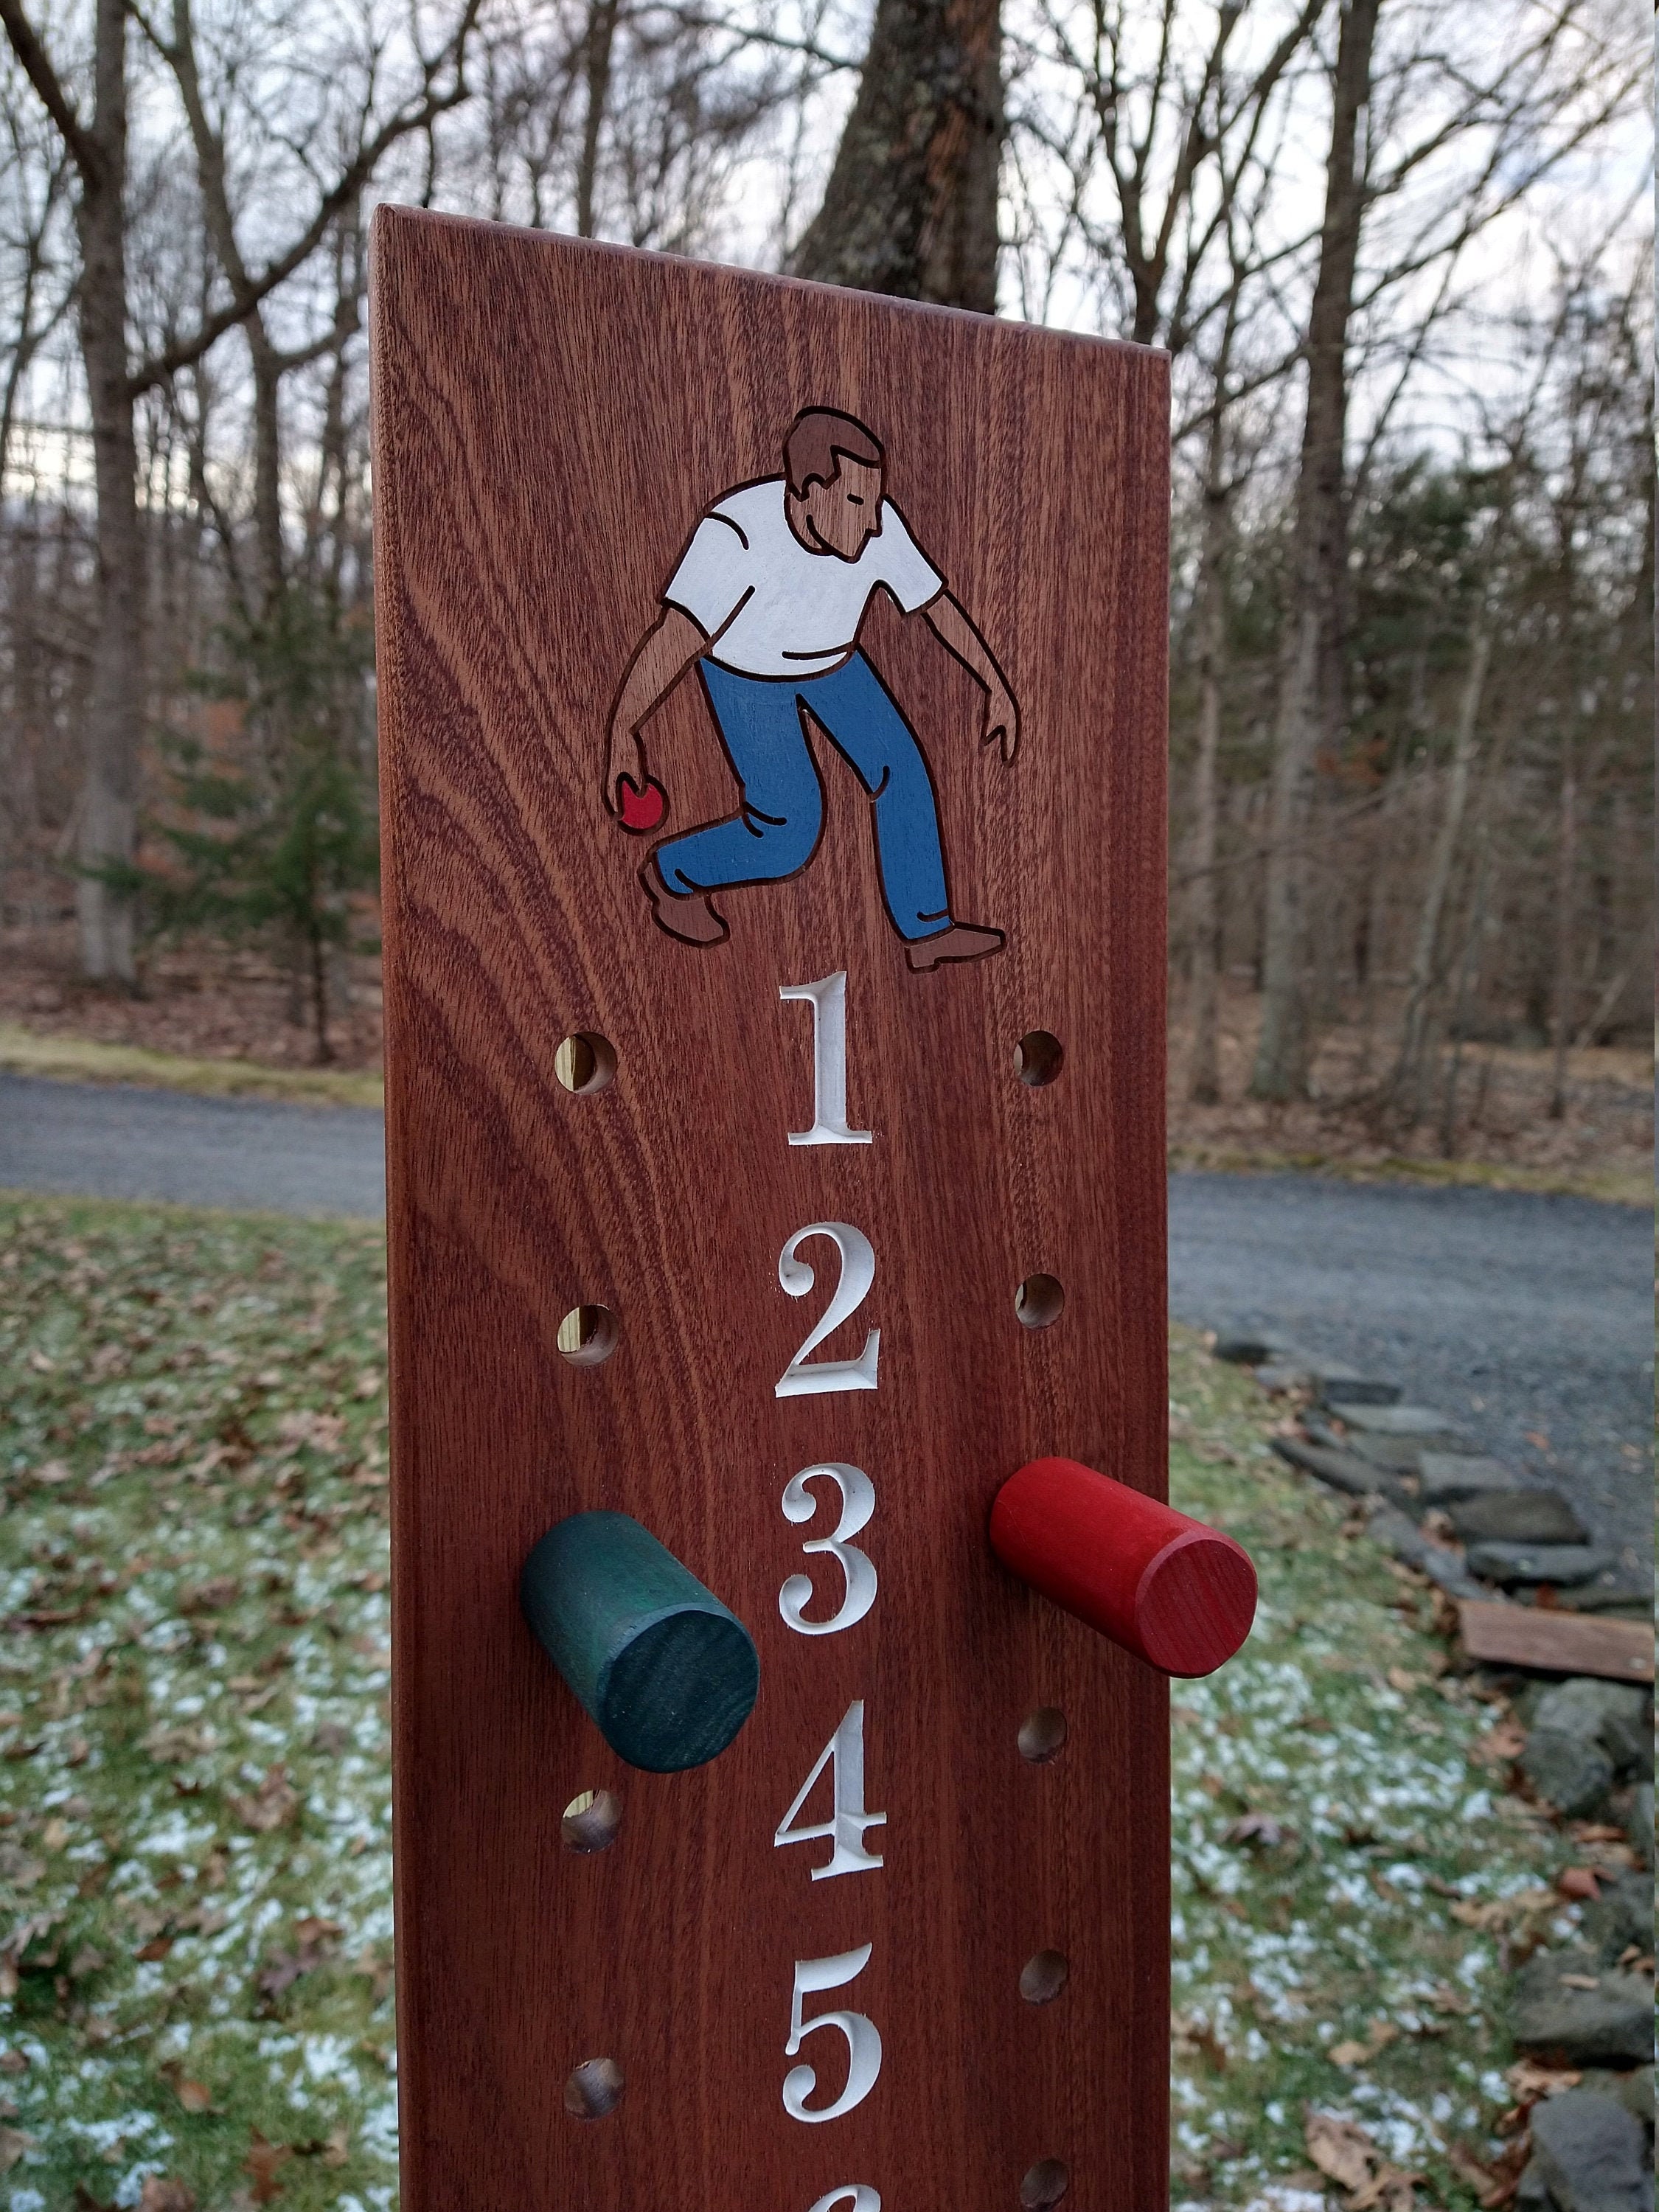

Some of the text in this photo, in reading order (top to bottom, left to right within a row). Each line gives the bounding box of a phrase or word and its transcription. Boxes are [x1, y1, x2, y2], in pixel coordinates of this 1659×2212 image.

[779, 970, 874, 1148] 1
[775, 1221, 881, 1399] 2
[779, 1462, 878, 1636] 3
[774, 1699, 886, 1882] 4
[782, 1942, 883, 2124] 5
